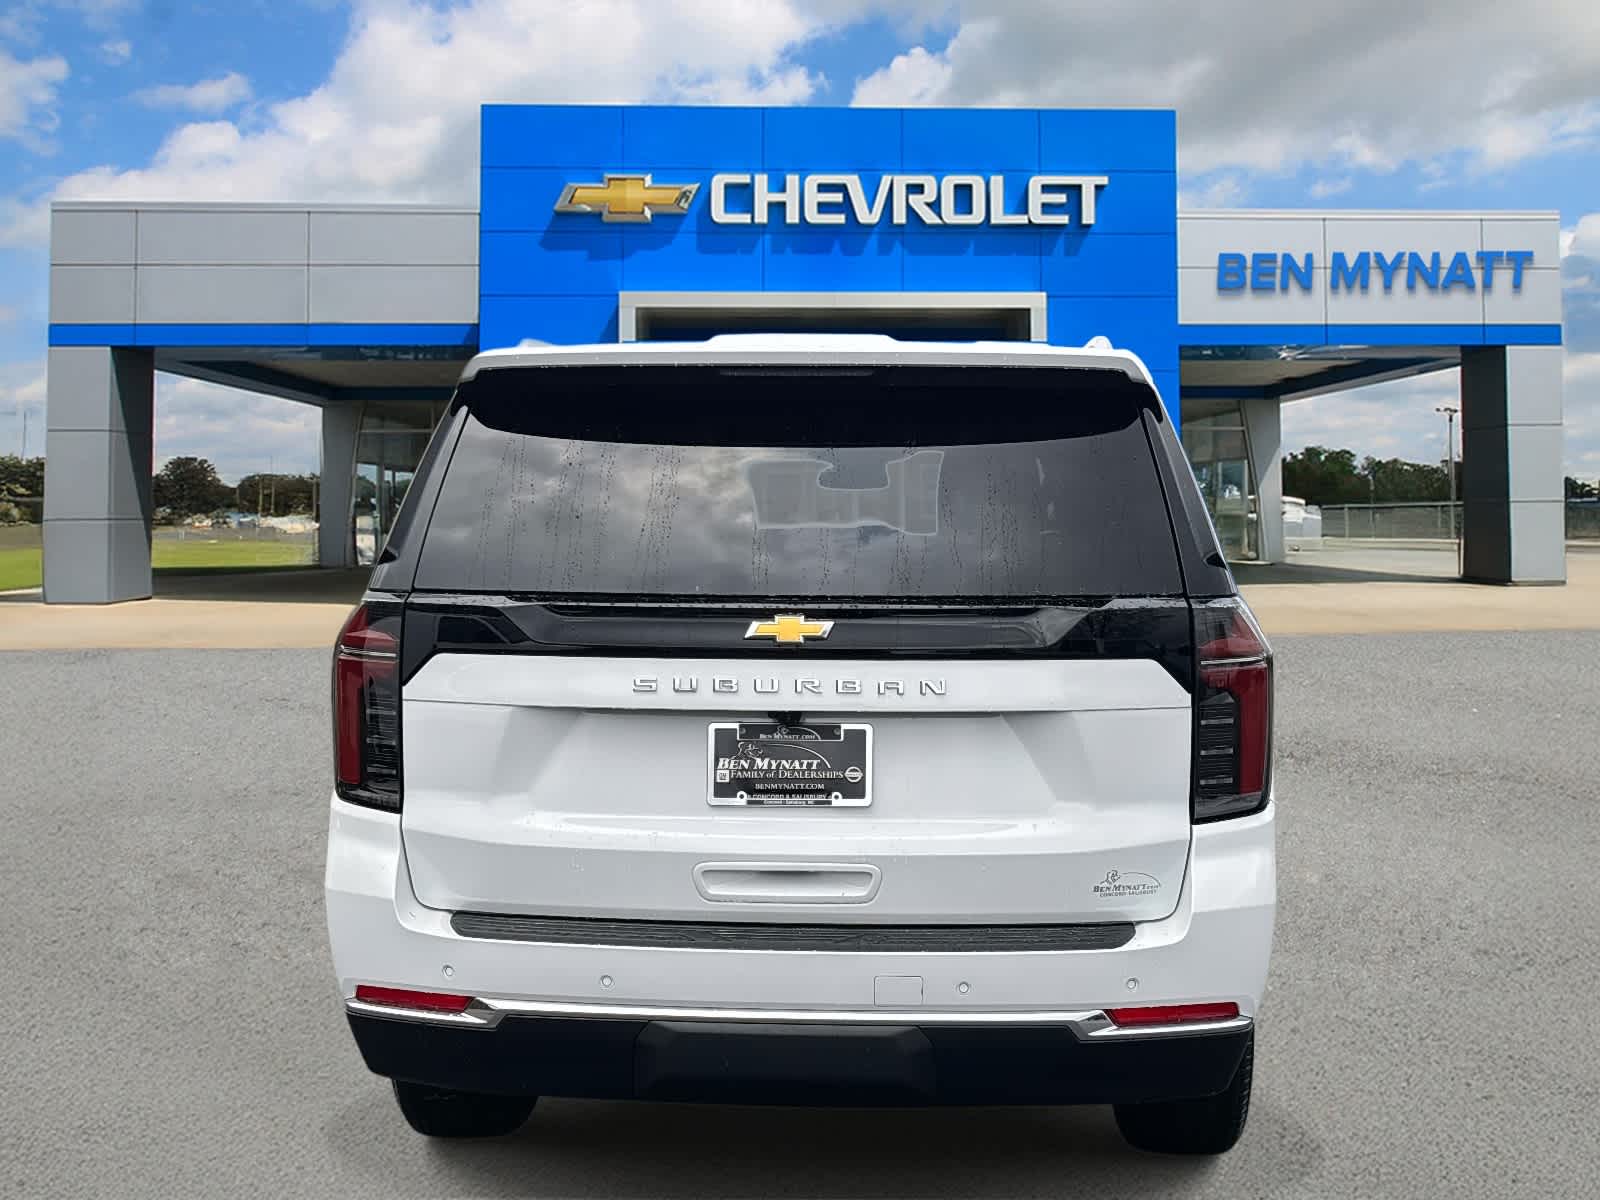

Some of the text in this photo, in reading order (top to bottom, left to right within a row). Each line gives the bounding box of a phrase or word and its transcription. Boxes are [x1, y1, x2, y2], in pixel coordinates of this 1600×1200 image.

[710, 173, 1109, 226] CHEVROLET
[1217, 250, 1534, 290] BEN MYNATT
[632, 675, 947, 696] SUBURBAN
[717, 757, 821, 770] BEN MYNATT
[730, 769, 765, 779] FAMILY
[766, 770, 777, 779] of
[779, 769, 844, 779] DEALERSHIPS
[1093, 885, 1112, 893] BEN
